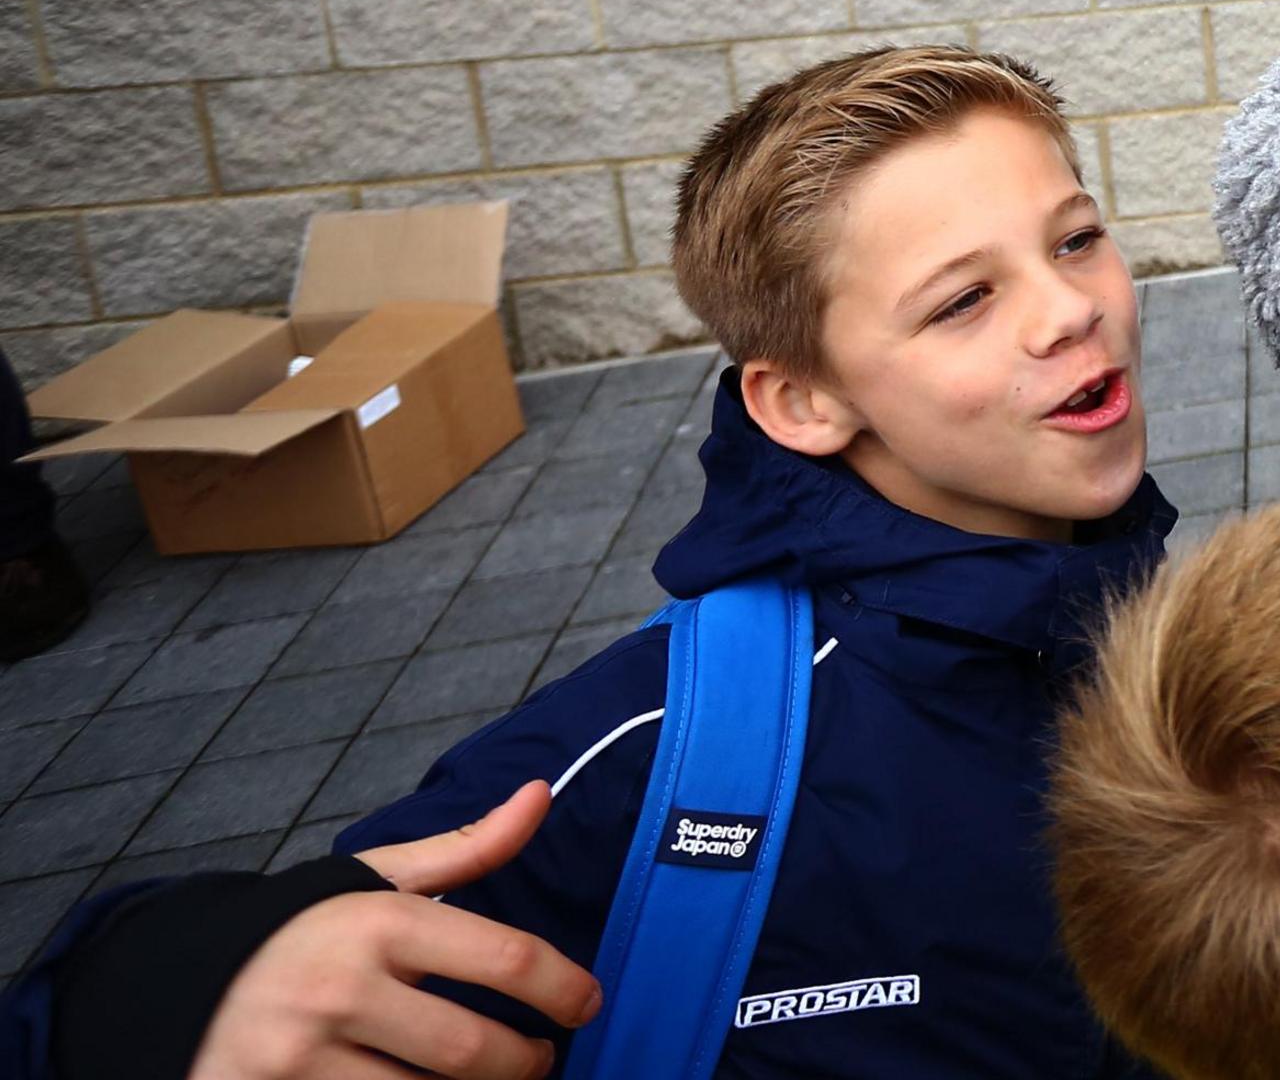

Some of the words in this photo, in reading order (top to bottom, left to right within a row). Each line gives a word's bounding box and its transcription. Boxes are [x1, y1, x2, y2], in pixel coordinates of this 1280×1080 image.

[671, 834, 730, 856] Japan
[677, 818, 758, 845] Superdry
[744, 980, 914, 1024] PROSTAR
